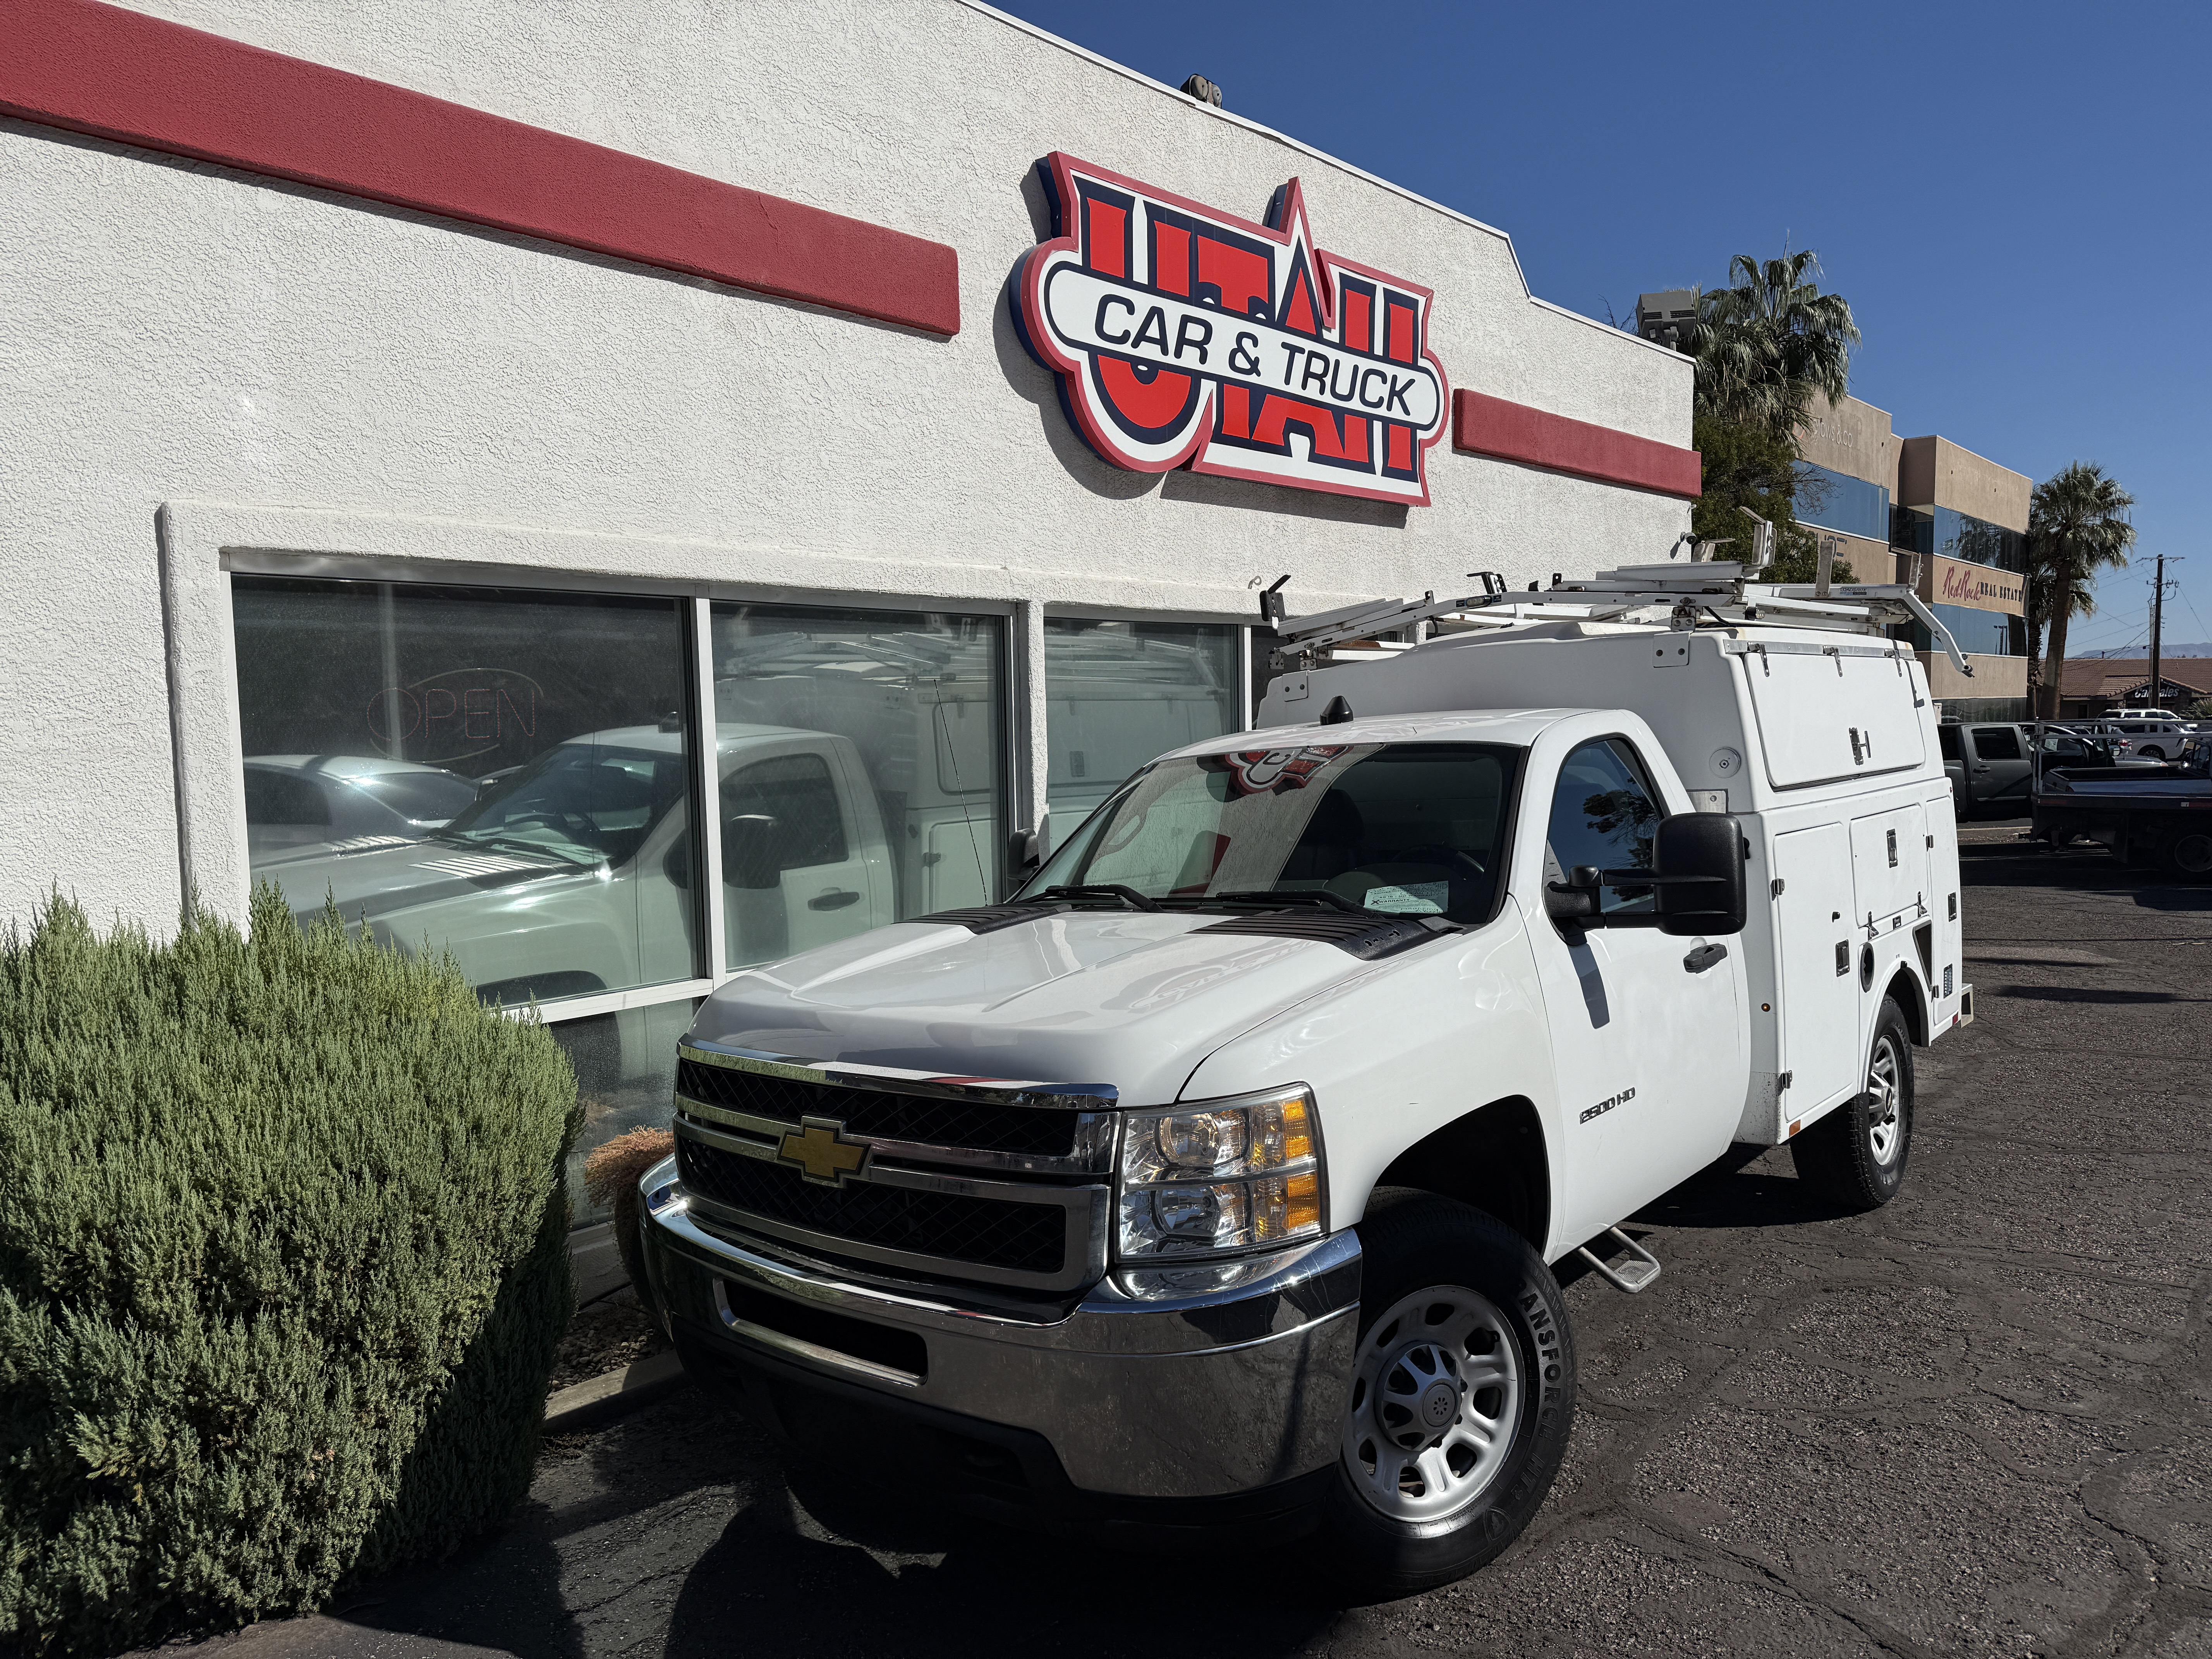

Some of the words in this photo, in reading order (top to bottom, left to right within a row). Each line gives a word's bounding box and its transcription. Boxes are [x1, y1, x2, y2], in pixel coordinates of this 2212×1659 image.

[1072, 174, 1420, 483] UTAH
[1095, 293, 1214, 365] CAR
[1228, 332, 1261, 377] &
[1281, 341, 1416, 416] TRUCK
[1836, 424, 1842, 445] &
[1980, 582, 1997, 597] REAL
[2000, 586, 2022, 602] ESTATE
[2159, 686, 2180, 697] ales
[367, 687, 535, 741] OPEN
[1617, 1087, 1635, 1106] HD
[1508, 1276, 1561, 1441] RANSFORCE
